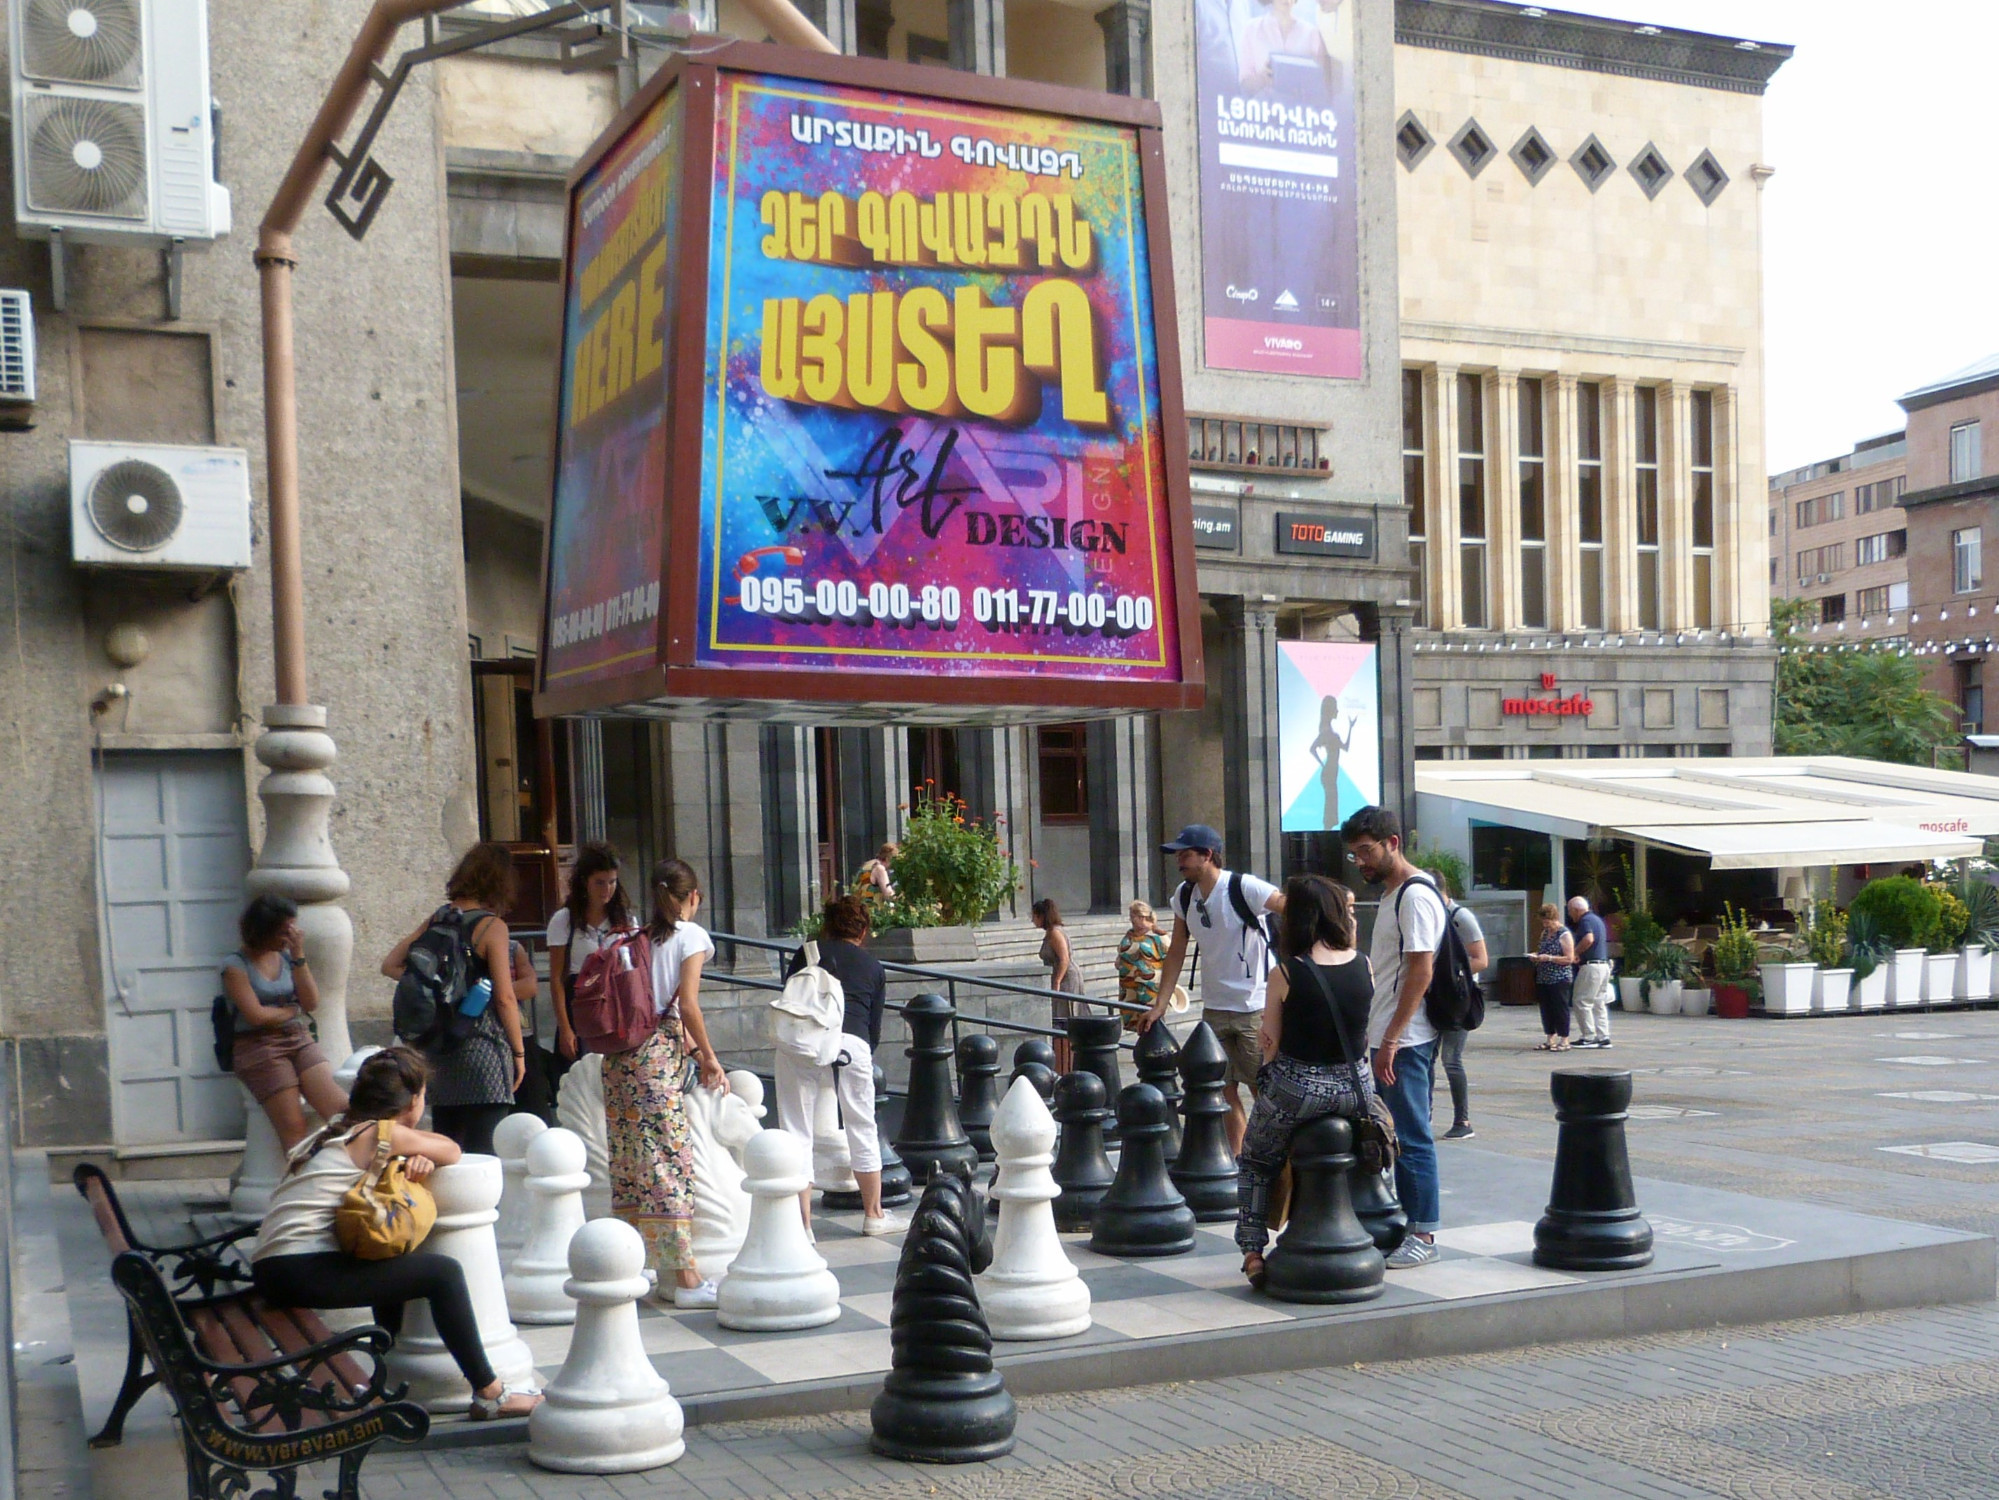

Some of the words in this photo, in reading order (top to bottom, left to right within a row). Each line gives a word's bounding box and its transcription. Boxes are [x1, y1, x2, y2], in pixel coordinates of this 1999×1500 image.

[1217, 94, 1338, 132] ԼՅՈՒԴՎԻԳ
[1217, 119, 1286, 143] ԱՆՈՒՆՈՎ
[1287, 128, 1338, 149] ՈԶՆԻՆ
[790, 113, 941, 158] ԱՐՏԱՔԻՆ
[950, 135, 1085, 180] ԳՈՎԱԶԴ
[760, 190, 847, 262] ՁԵՐ
[858, 190, 1092, 270] ԳՈՎԱԶԴՆ
[574, 235, 667, 426] HERE
[759, 278, 1108, 423] ԱՅՍՏԵՂ
[1264, 336, 1303, 351] VIVARO
[823, 425, 985, 540] Art
[963, 510, 1130, 555] DESIGN
[740, 575, 961, 624] 095-00-00-80
[972, 585, 1153, 632] 011-77-00-00
[1503, 692, 1594, 716] moscafe
[1919, 818, 1968, 833] moscafe
[206, 1415, 384, 1463] www.yerevan.am
